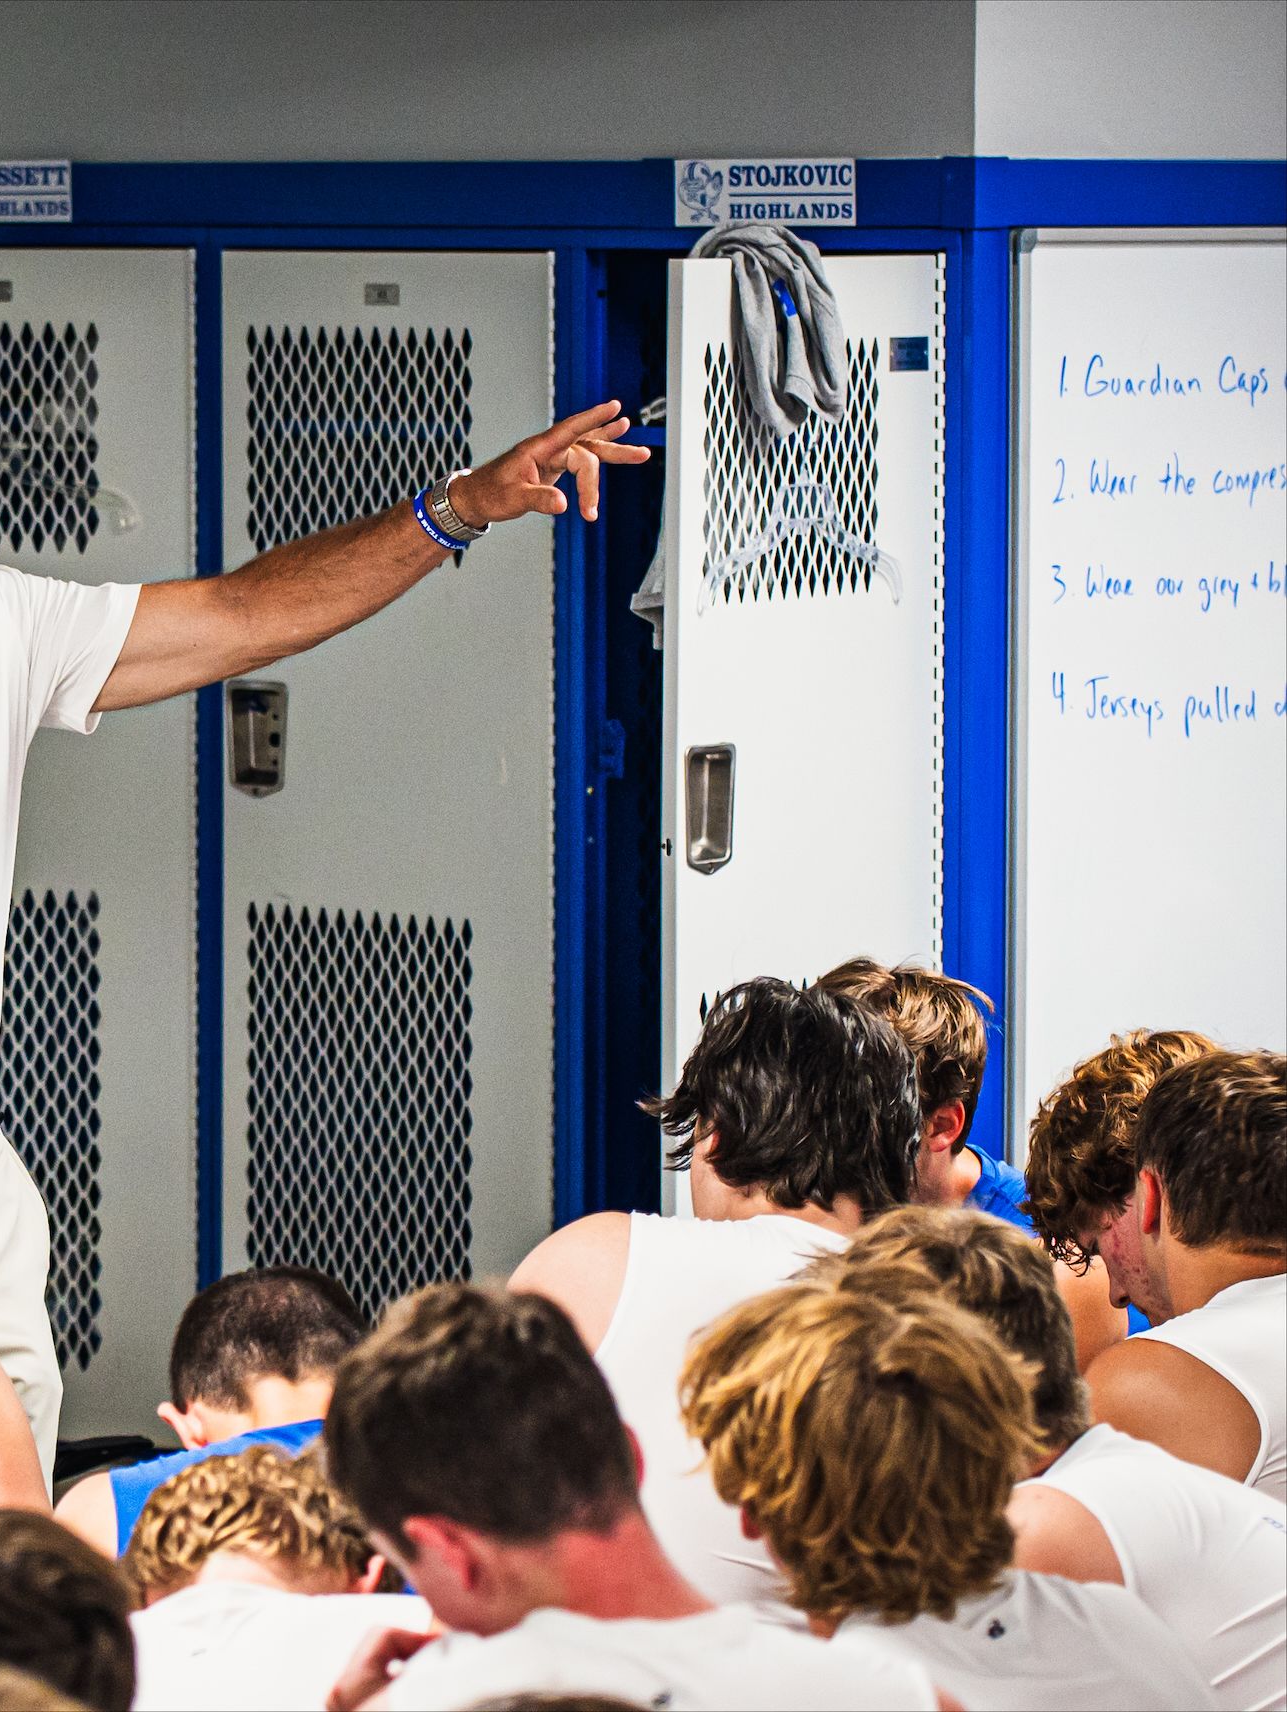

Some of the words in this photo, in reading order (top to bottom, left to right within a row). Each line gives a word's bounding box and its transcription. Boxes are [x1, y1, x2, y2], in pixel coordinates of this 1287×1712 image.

[728, 163, 853, 188] STOJKOVIC
[728, 202, 853, 220] HIGHLANDS
[1084, 353, 1202, 397] Guardian
[1218, 355, 1268, 407] Caps
[1158, 451, 1196, 495] the
[1198, 575, 1239, 613] grey
[1084, 675, 1164, 738] Jerseys
[1185, 685, 1258, 738] pulled
